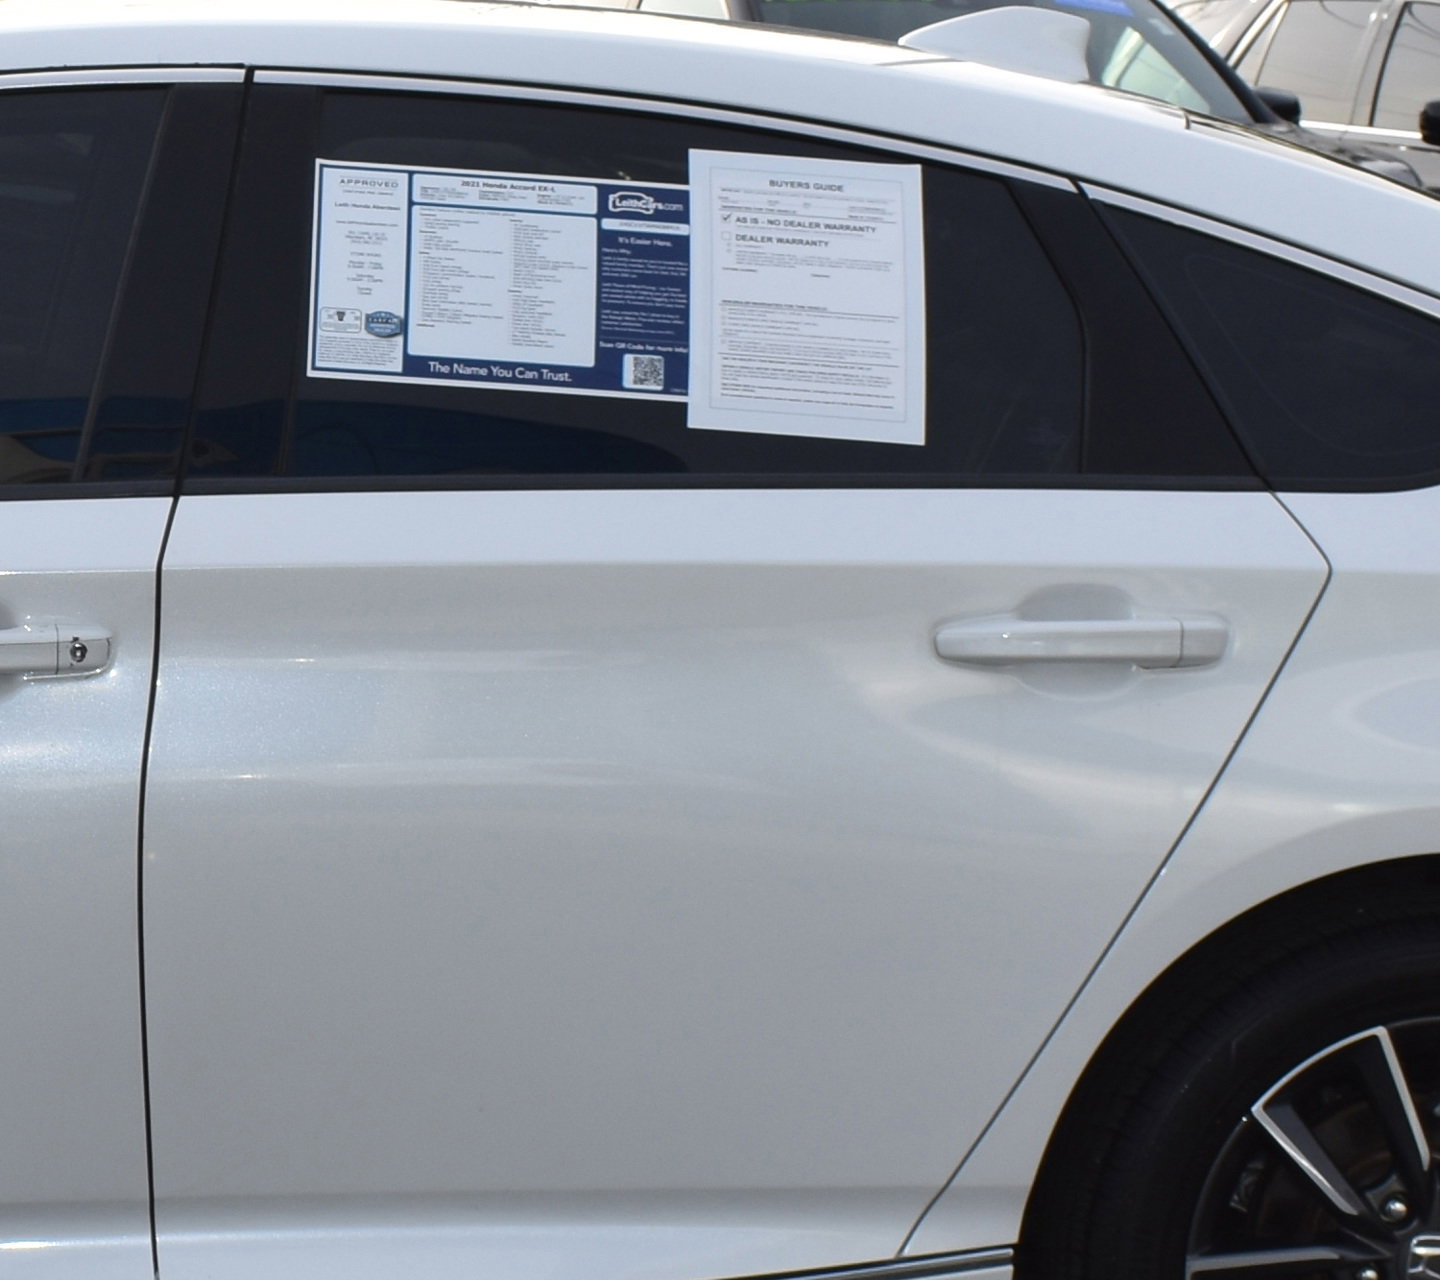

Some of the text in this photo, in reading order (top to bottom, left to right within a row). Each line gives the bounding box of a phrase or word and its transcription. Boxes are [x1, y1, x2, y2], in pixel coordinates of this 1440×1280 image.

[339, 178, 399, 189] APPROVED
[461, 180, 480, 188] 2021
[482, 181, 508, 190] Honda
[510, 183, 536, 191] Accord
[768, 179, 810, 190] BUYERS
[813, 181, 844, 192] GUIDE
[616, 196, 684, 211] LeithCars.com
[735, 215, 748, 224] AS
[750, 216, 759, 225] IS
[767, 218, 781, 226] NO
[783, 219, 821, 229] DEALER
[823, 222, 877, 233] WARRANTY
[735, 234, 829, 247] DEALER WARRANTY
[428, 361, 573, 382] The Name You Can Trust.
